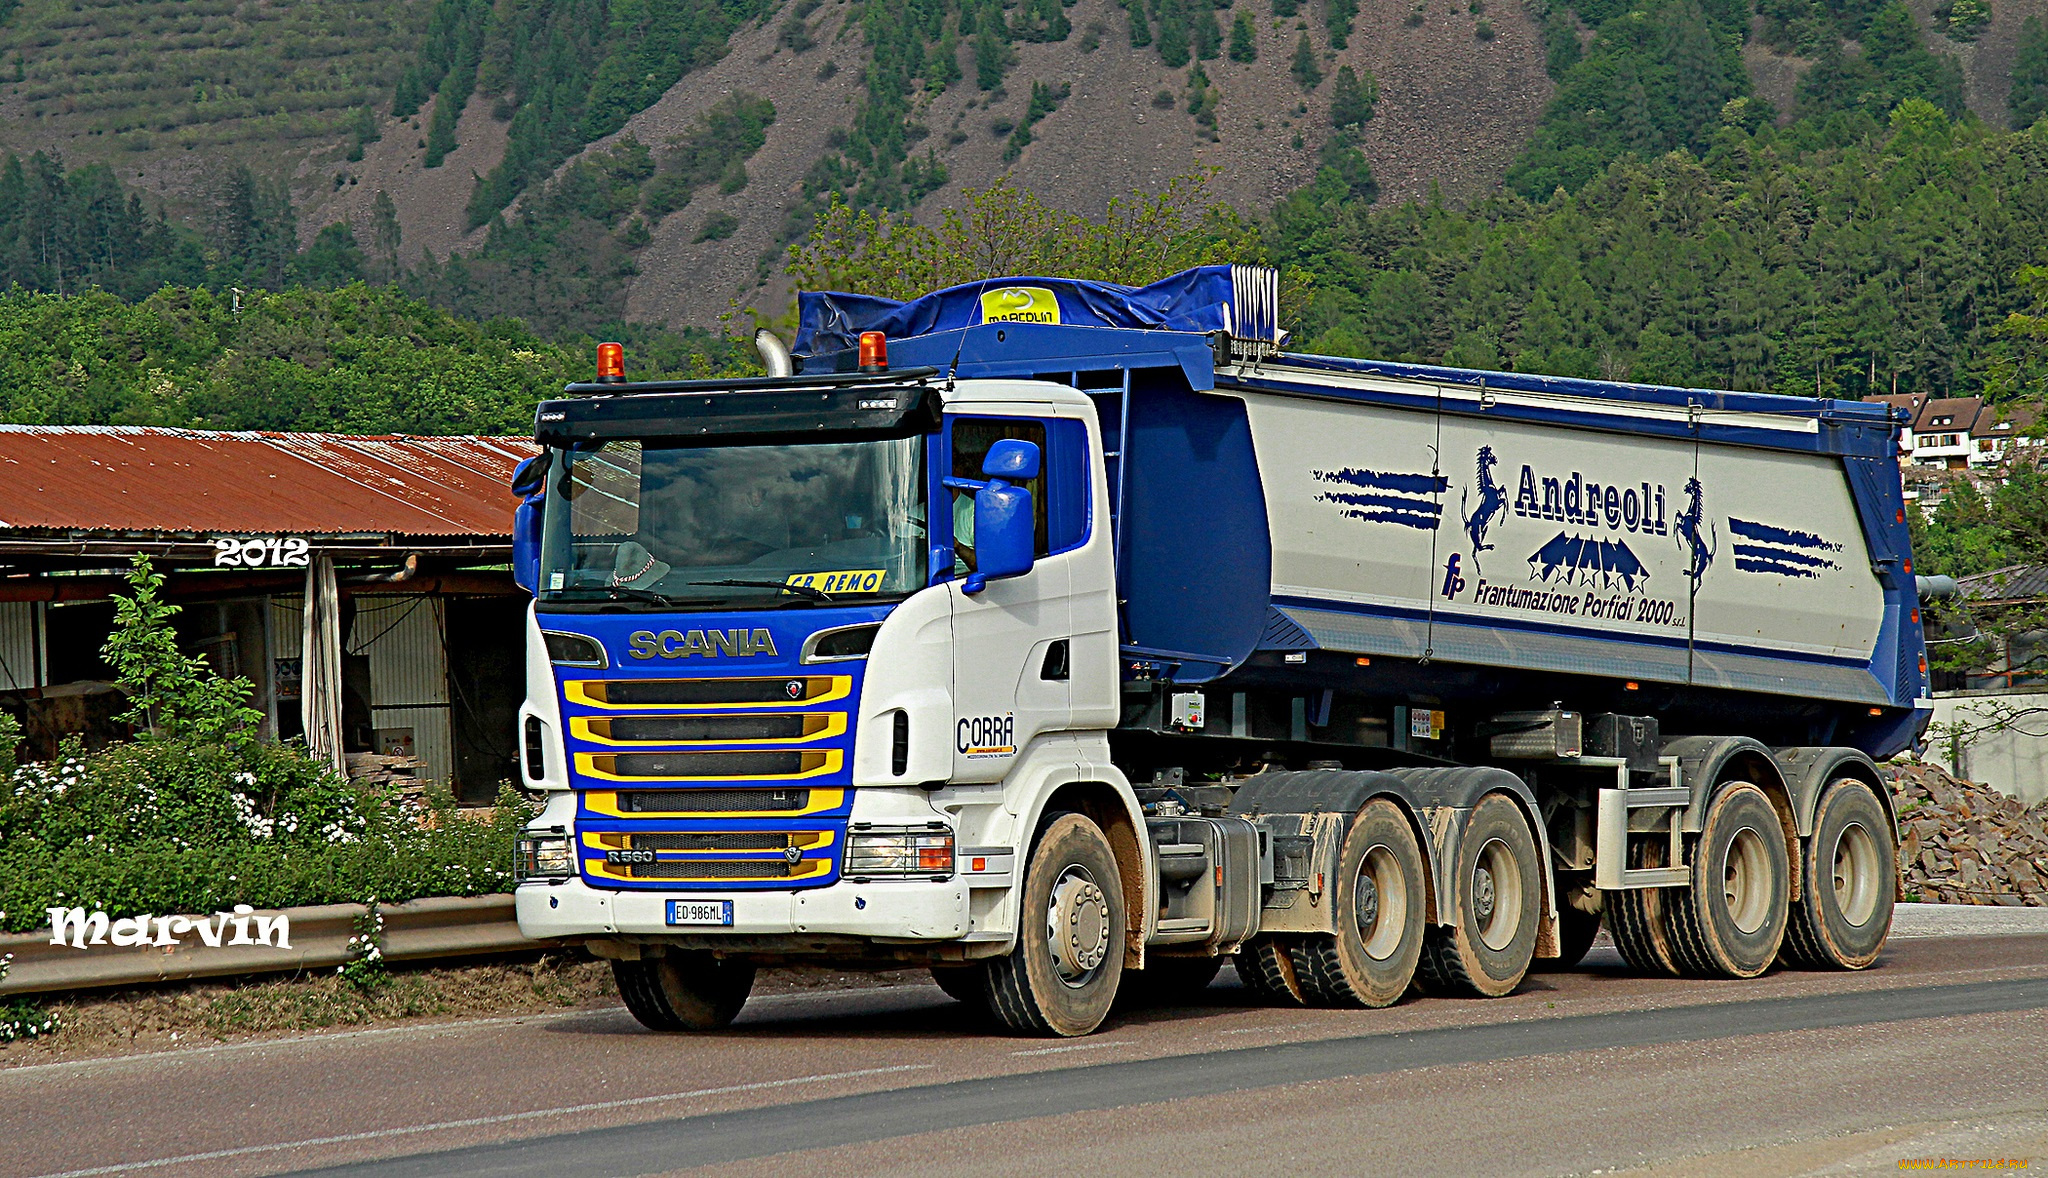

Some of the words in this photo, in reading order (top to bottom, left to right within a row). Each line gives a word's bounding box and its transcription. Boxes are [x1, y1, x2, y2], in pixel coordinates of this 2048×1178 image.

[1515, 464, 1668, 536] Andreoli
[823, 573, 877, 591] REMO
[1473, 578, 1580, 614] Frantumazione
[1581, 592, 1635, 621] Porfidi
[1635, 599, 1675, 627] 2000
[628, 628, 779, 660] SCANIA
[607, 851, 620, 863] R
[620, 851, 653, 863] 560
